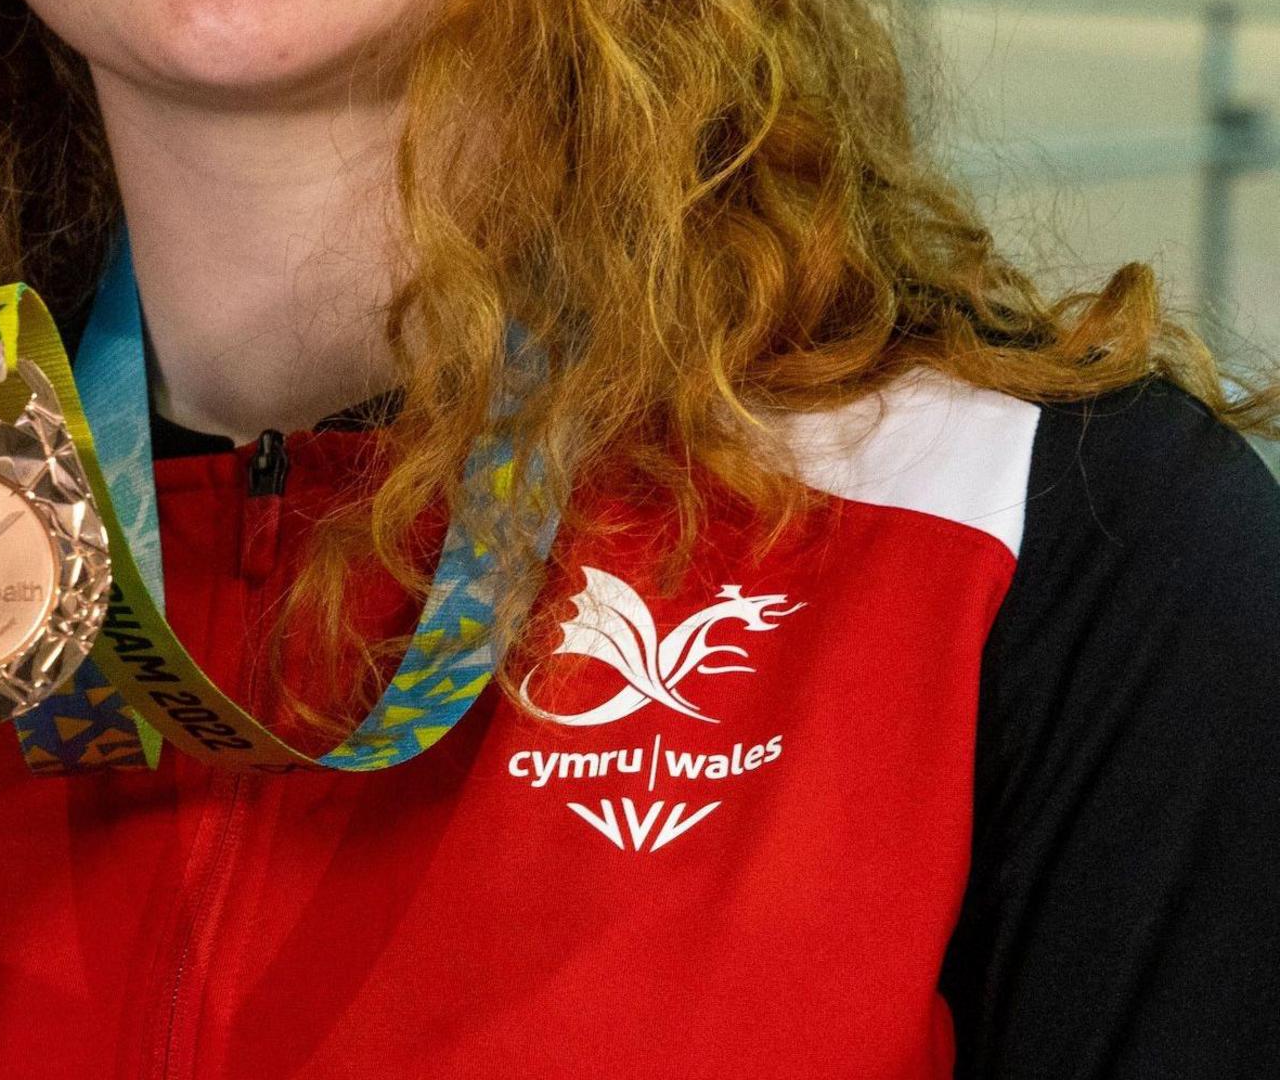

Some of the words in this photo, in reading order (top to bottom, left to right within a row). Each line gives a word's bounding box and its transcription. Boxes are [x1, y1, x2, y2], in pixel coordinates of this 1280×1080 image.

[148, 690, 254, 752] 2022
[507, 745, 644, 789] cymru
[663, 734, 784, 781] wales
